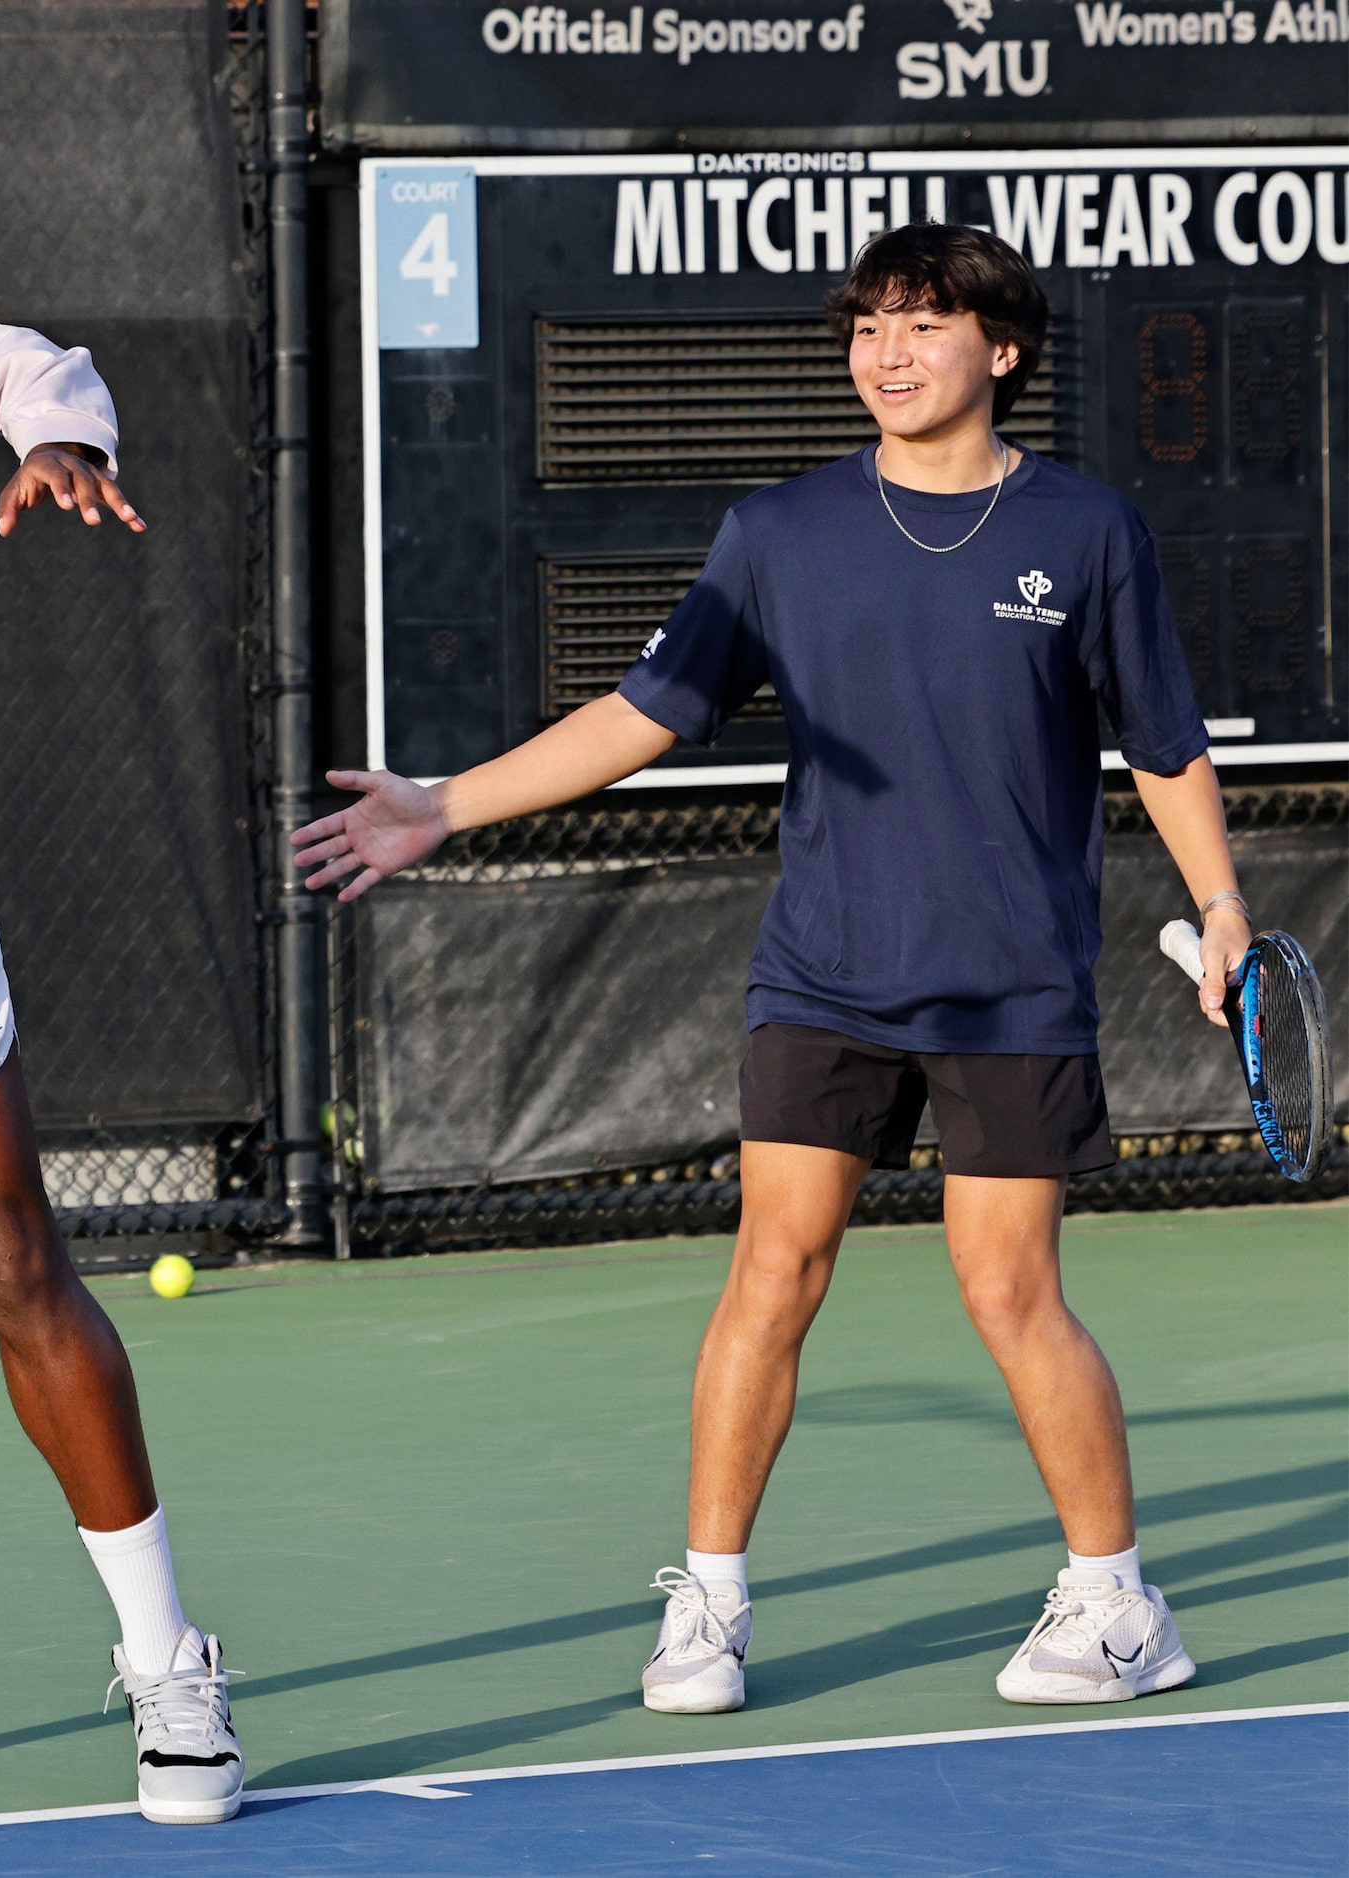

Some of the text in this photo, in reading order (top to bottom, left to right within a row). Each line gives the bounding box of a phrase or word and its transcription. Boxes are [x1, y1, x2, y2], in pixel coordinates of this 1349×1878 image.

[481, 4, 865, 65] Official Sponsor of
[1075, 1, 1257, 48] Women's
[896, 39, 1050, 100] SMU
[697, 151, 865, 174] DAKTRONICS
[390, 180, 460, 204] COURT
[398, 211, 458, 296] 4
[993, 602, 1067, 621] DALLAS TENNIS
[995, 611, 1063, 627] EDUCATION ACADEMY
